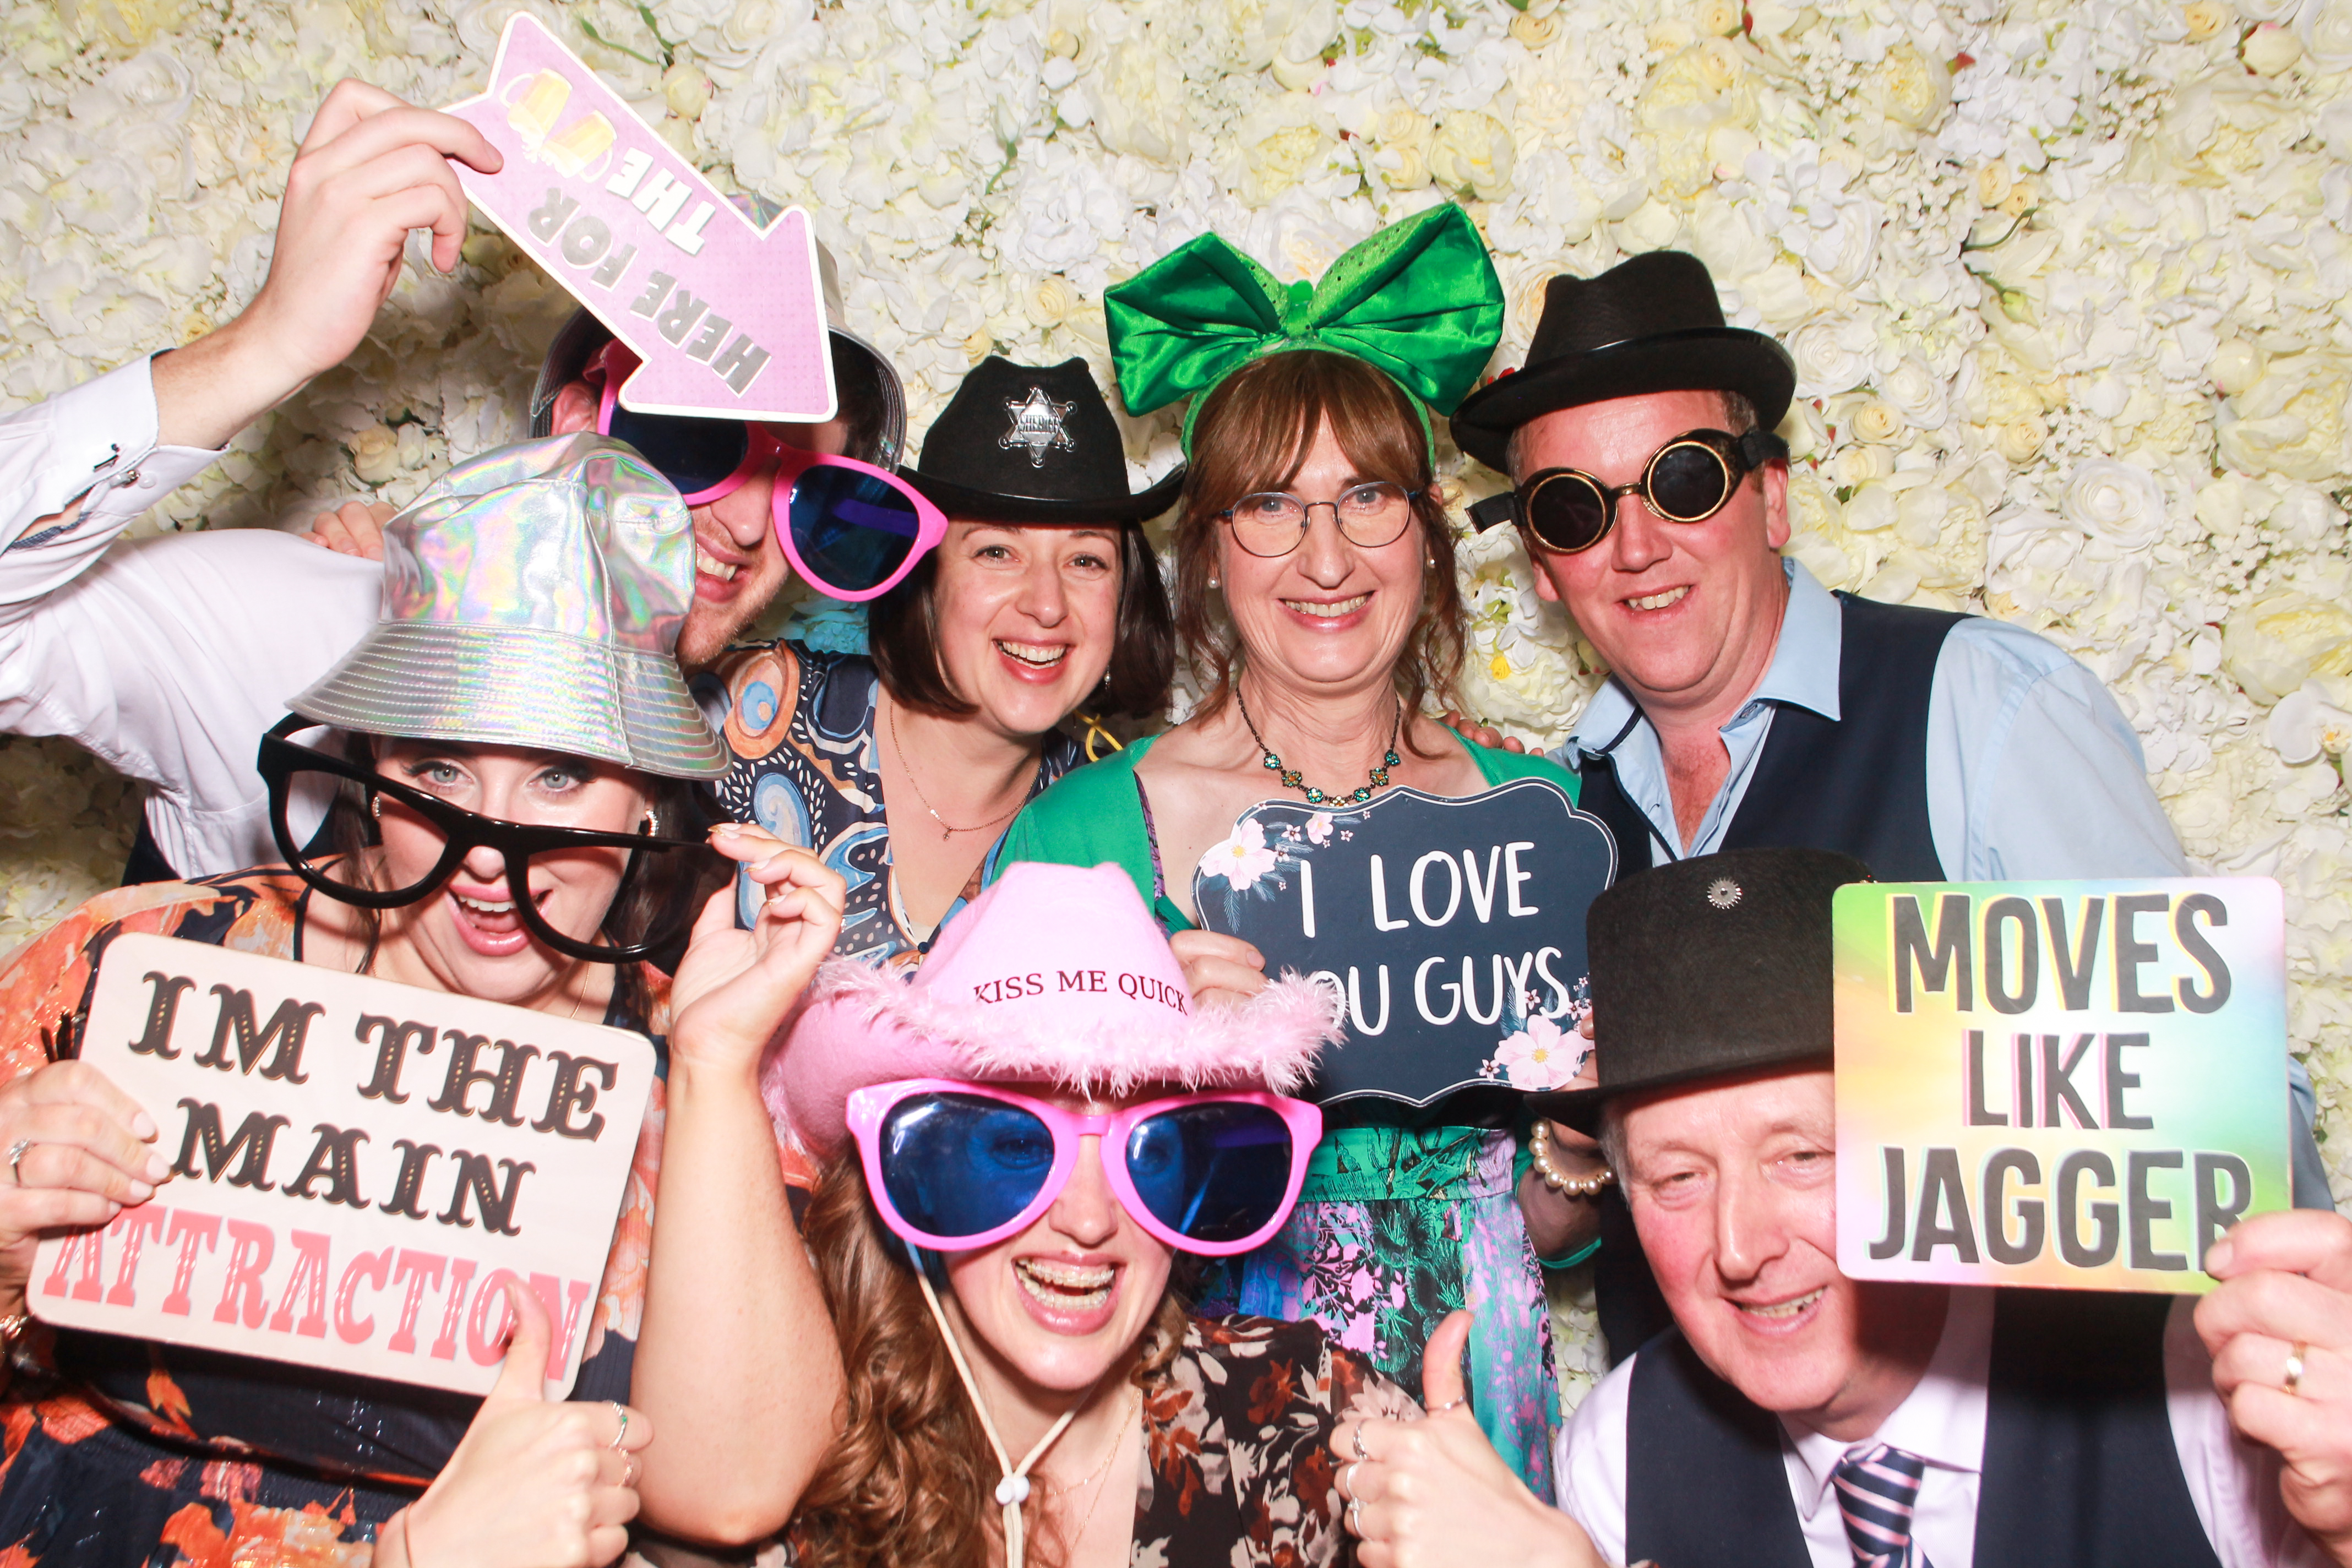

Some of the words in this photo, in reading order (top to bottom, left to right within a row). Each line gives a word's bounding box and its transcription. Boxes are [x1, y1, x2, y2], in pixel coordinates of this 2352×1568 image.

[527, 187, 638, 292] FOR
[606, 147, 716, 256] THE
[629, 270, 771, 399] HERE
[1300, 859, 1315, 938] I
[1370, 842, 1539, 932] LOVE
[973, 973, 1044, 1004] KISS
[1057, 971, 1107, 992] ME
[1118, 973, 1188, 1016] QUICK
[1311, 964, 1390, 1036] OU
[1414, 946, 1571, 1026] GUYS
[1886, 891, 2232, 1015] MOVES
[128, 970, 325, 1084] IM
[355, 1012, 619, 1142] THE
[1962, 1028, 2154, 1130] LIKE
[171, 1098, 536, 1237] MAIN
[1864, 1145, 2252, 1272] JAGGER
[42, 1203, 592, 1382] ATTRACTION
